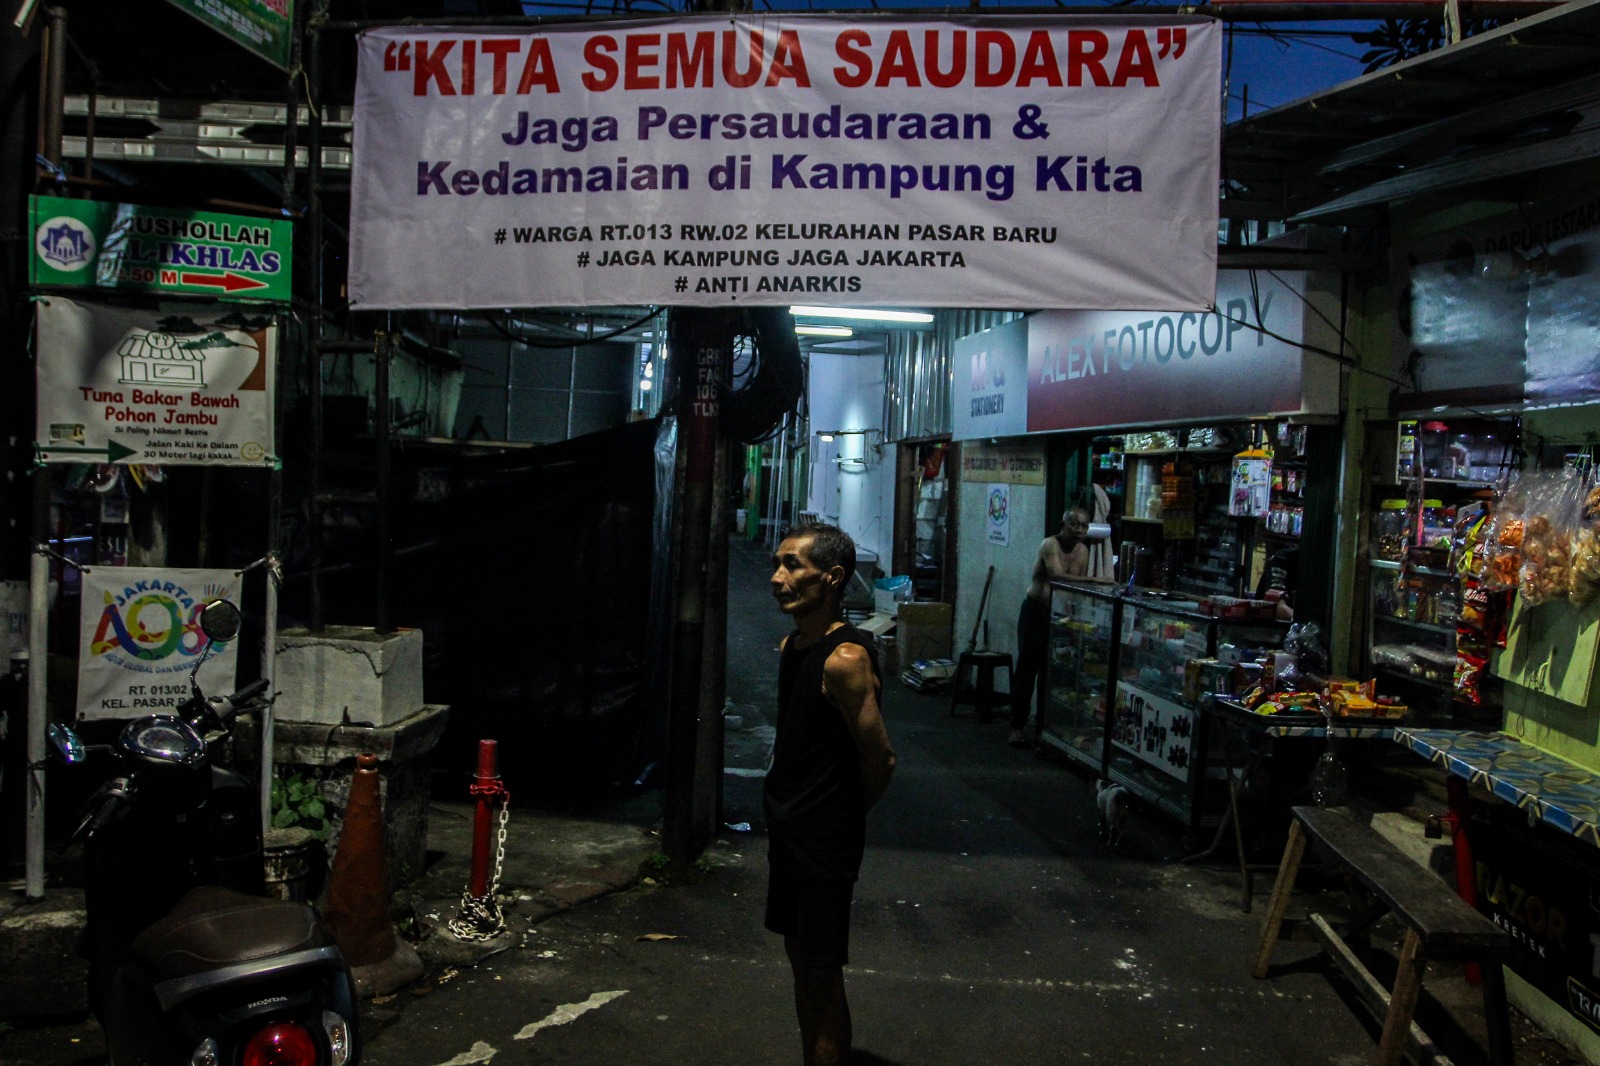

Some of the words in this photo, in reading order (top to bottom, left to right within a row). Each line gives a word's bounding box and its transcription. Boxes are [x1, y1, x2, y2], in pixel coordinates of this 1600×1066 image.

[581, 30, 811, 93] SEMUA
[501, 111, 618, 152] Jaga
[637, 104, 991, 140] Persaudaraan
[1012, 104, 1050, 140] &
[417, 156, 689, 195] Kedamaian
[708, 155, 751, 190] di
[771, 154, 1014, 200] Kampung
[1036, 155, 1142, 192] Kita
[130, 217, 270, 245] USHOLLAH
[513, 226, 593, 242] WARGA
[600, 224, 672, 241] RT.013
[680, 224, 747, 241] RW.02
[755, 223, 900, 240] KELURAHAN
[908, 225, 985, 241] PASAR
[993, 226, 1057, 243] BARU
[123, 239, 280, 273] L-IKHLAS
[596, 250, 656, 267] JAGA
[664, 250, 779, 267] KAMPUNG
[787, 249, 848, 266] JAGA
[856, 250, 966, 267] JAKARTA
[131, 267, 154, 282] 50
[161, 271, 177, 283] M
[696, 276, 748, 292] ANTI
[756, 275, 861, 292] ANARKIS
[1041, 337, 1096, 385] ALEX
[1103, 290, 1274, 374] FOTOCOPY
[79, 386, 123, 403] Tuna
[133, 389, 182, 406] Bakar
[191, 392, 239, 408] Bawah
[696, 383, 717, 400] 106
[105, 406, 156, 423] Pohon
[164, 409, 218, 425] Jambu
[126, 426, 150, 436] Paling
[153, 427, 182, 435] Nikmat
[146, 440, 172, 448] Jalan
[196, 441, 208, 449] Ke
[211, 441, 238, 449] Dalam
[159, 451, 187, 459] Meter
[189, 451, 206, 461] lagi
[115, 579, 194, 609] JAKARTA
[124, 662, 153, 674] GLOBAL
[155, 666, 172, 674] DAN
[129, 686, 147, 695] RT.
[151, 685, 187, 695] 013/02
[102, 699, 129, 709] KEL.
[133, 697, 175, 708] PASAR
[1493, 912, 1546, 960] KRETEK
[248, 996, 288, 1008] HONDA
